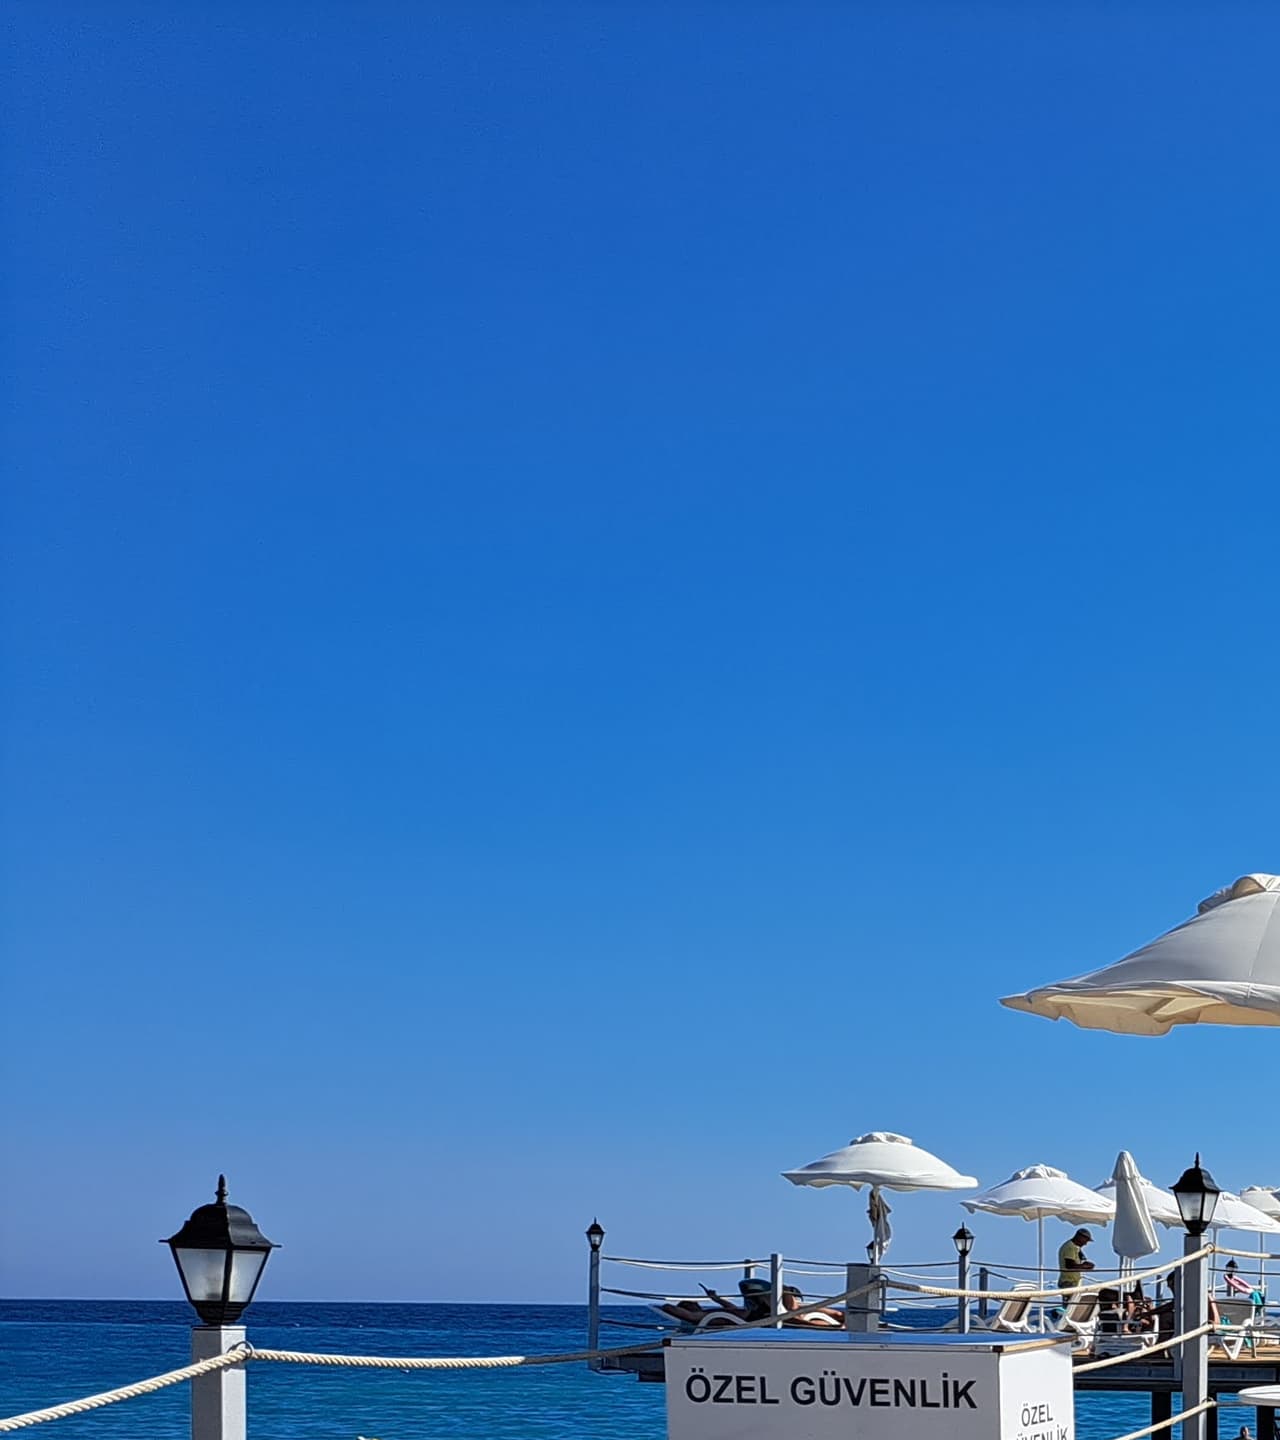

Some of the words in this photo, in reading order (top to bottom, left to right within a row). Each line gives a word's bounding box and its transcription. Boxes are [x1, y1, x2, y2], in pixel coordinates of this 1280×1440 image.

[685, 1368, 779, 1404] ÖZEL
[790, 1370, 978, 1409] GÜVENLİK
[1021, 1403, 1054, 1427] ÖZEL
